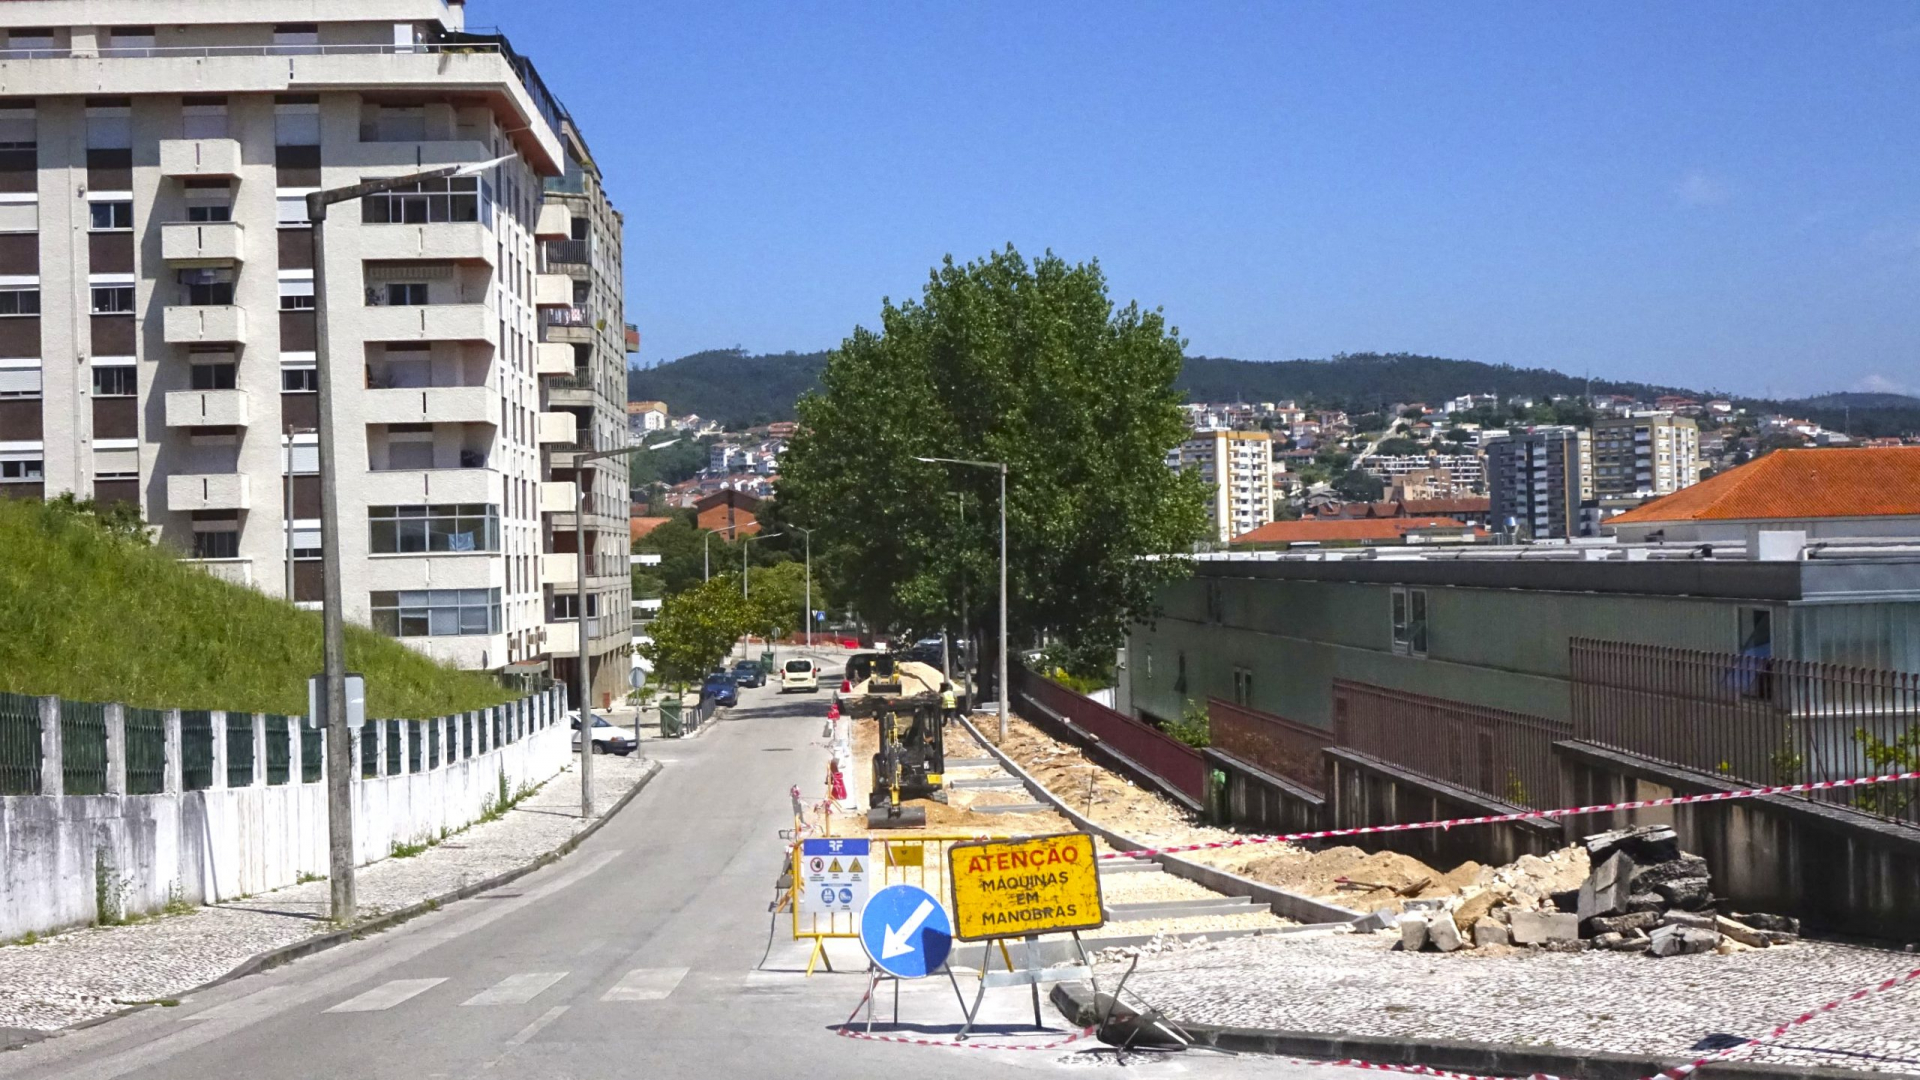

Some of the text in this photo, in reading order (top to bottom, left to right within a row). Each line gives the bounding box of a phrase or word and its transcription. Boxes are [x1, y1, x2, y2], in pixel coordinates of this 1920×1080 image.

[968, 843, 1078, 873] ATENÇÃO
[1016, 892, 1039, 905] EM
[982, 904, 1077, 925] MANOBRAS
